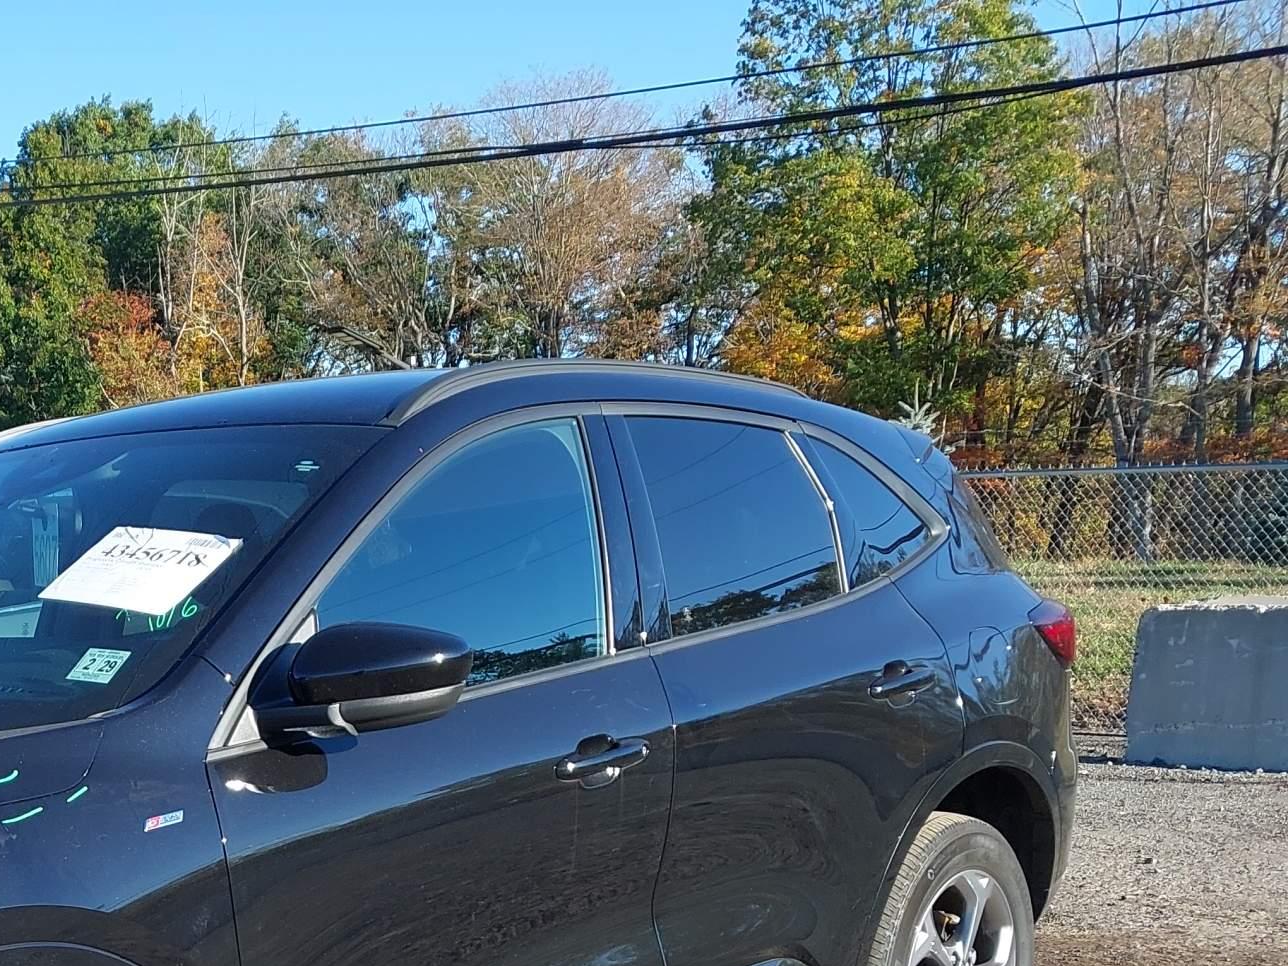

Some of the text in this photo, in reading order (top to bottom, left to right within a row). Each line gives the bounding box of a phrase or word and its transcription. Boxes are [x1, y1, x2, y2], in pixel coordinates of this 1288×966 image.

[102, 543, 209, 568] 43456718
[82, 658, 118, 673] 2 29
